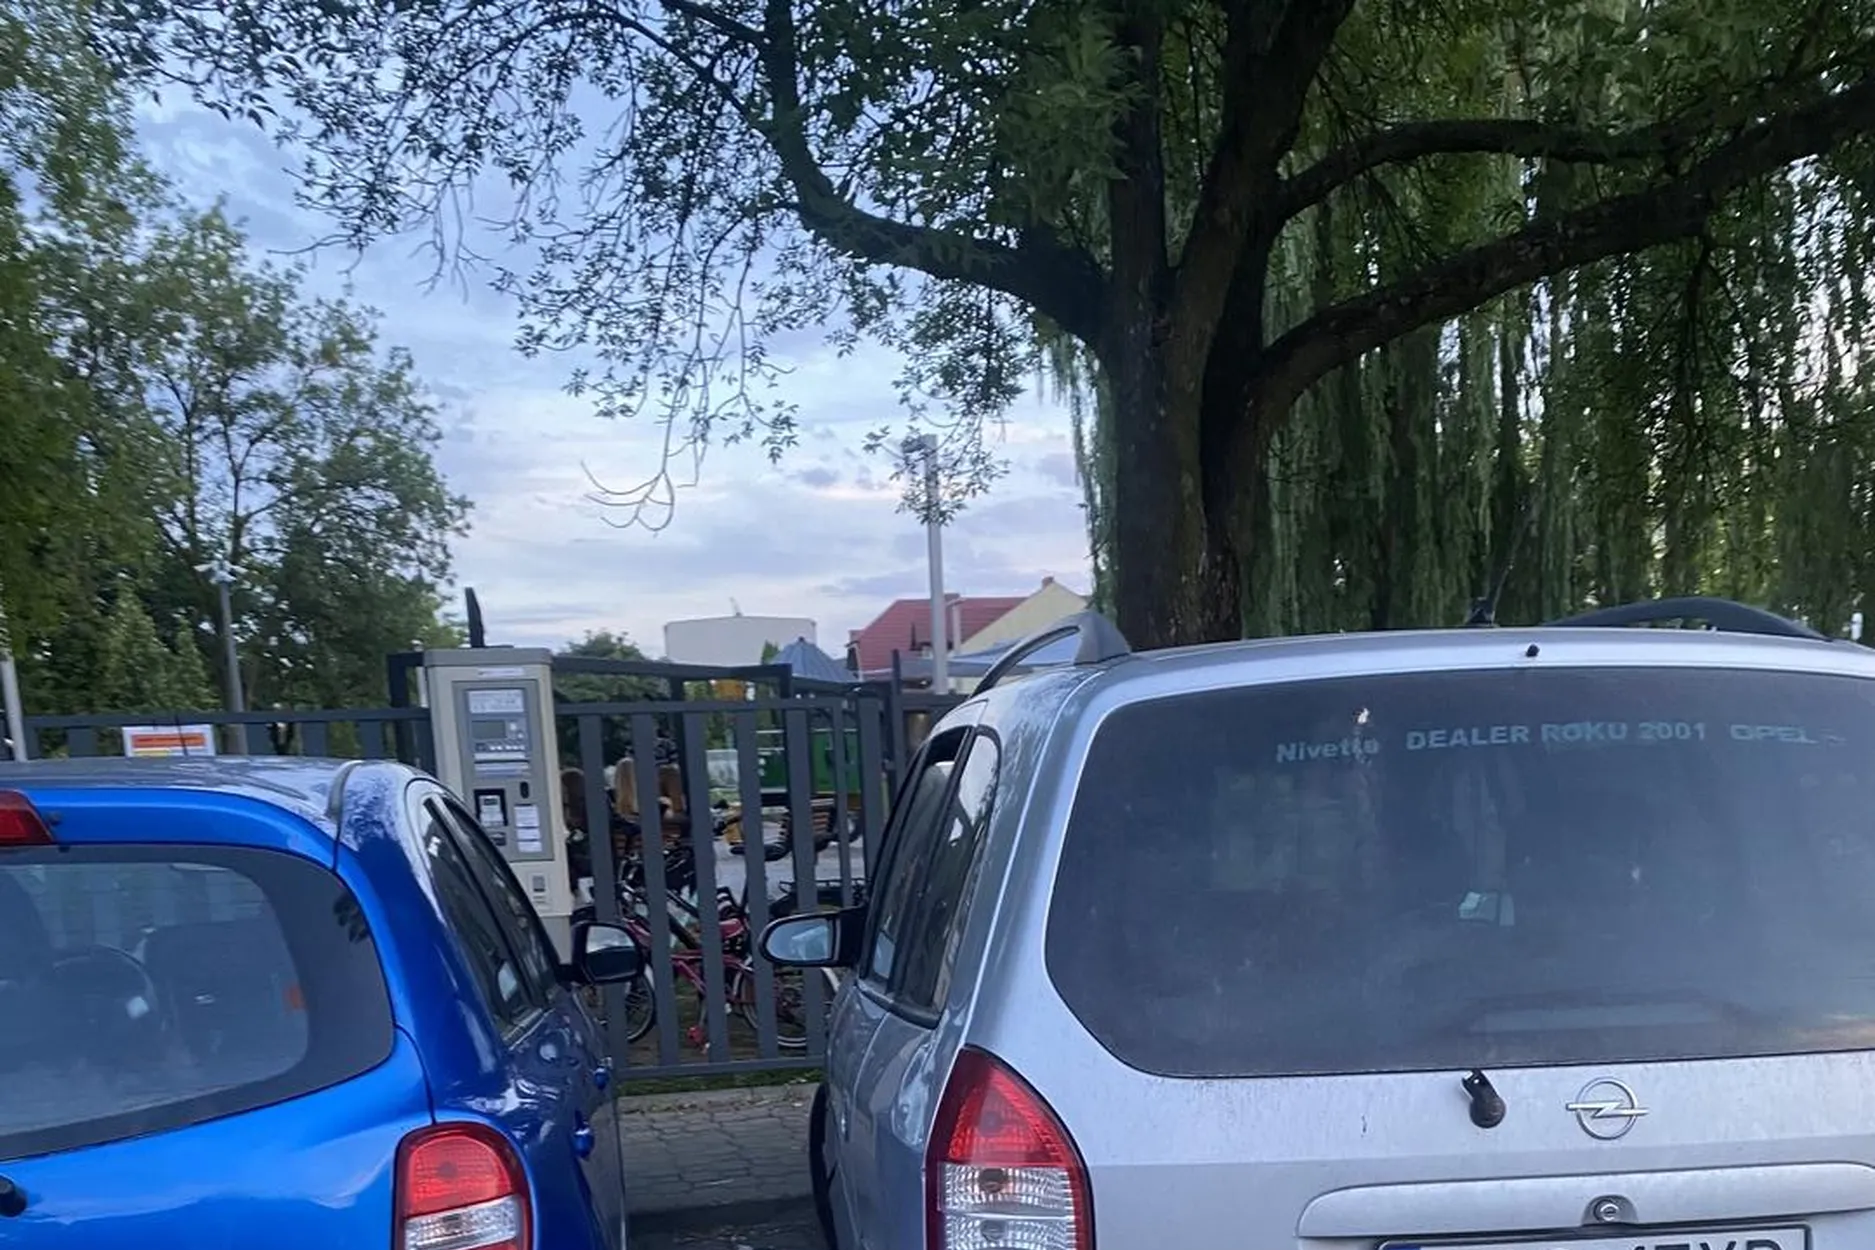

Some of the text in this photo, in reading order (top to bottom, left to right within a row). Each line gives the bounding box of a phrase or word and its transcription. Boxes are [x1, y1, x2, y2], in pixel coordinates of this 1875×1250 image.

[1406, 724, 1530, 751] DEALER
[1541, 721, 1628, 744] ROKU
[1638, 721, 1706, 741] 2001
